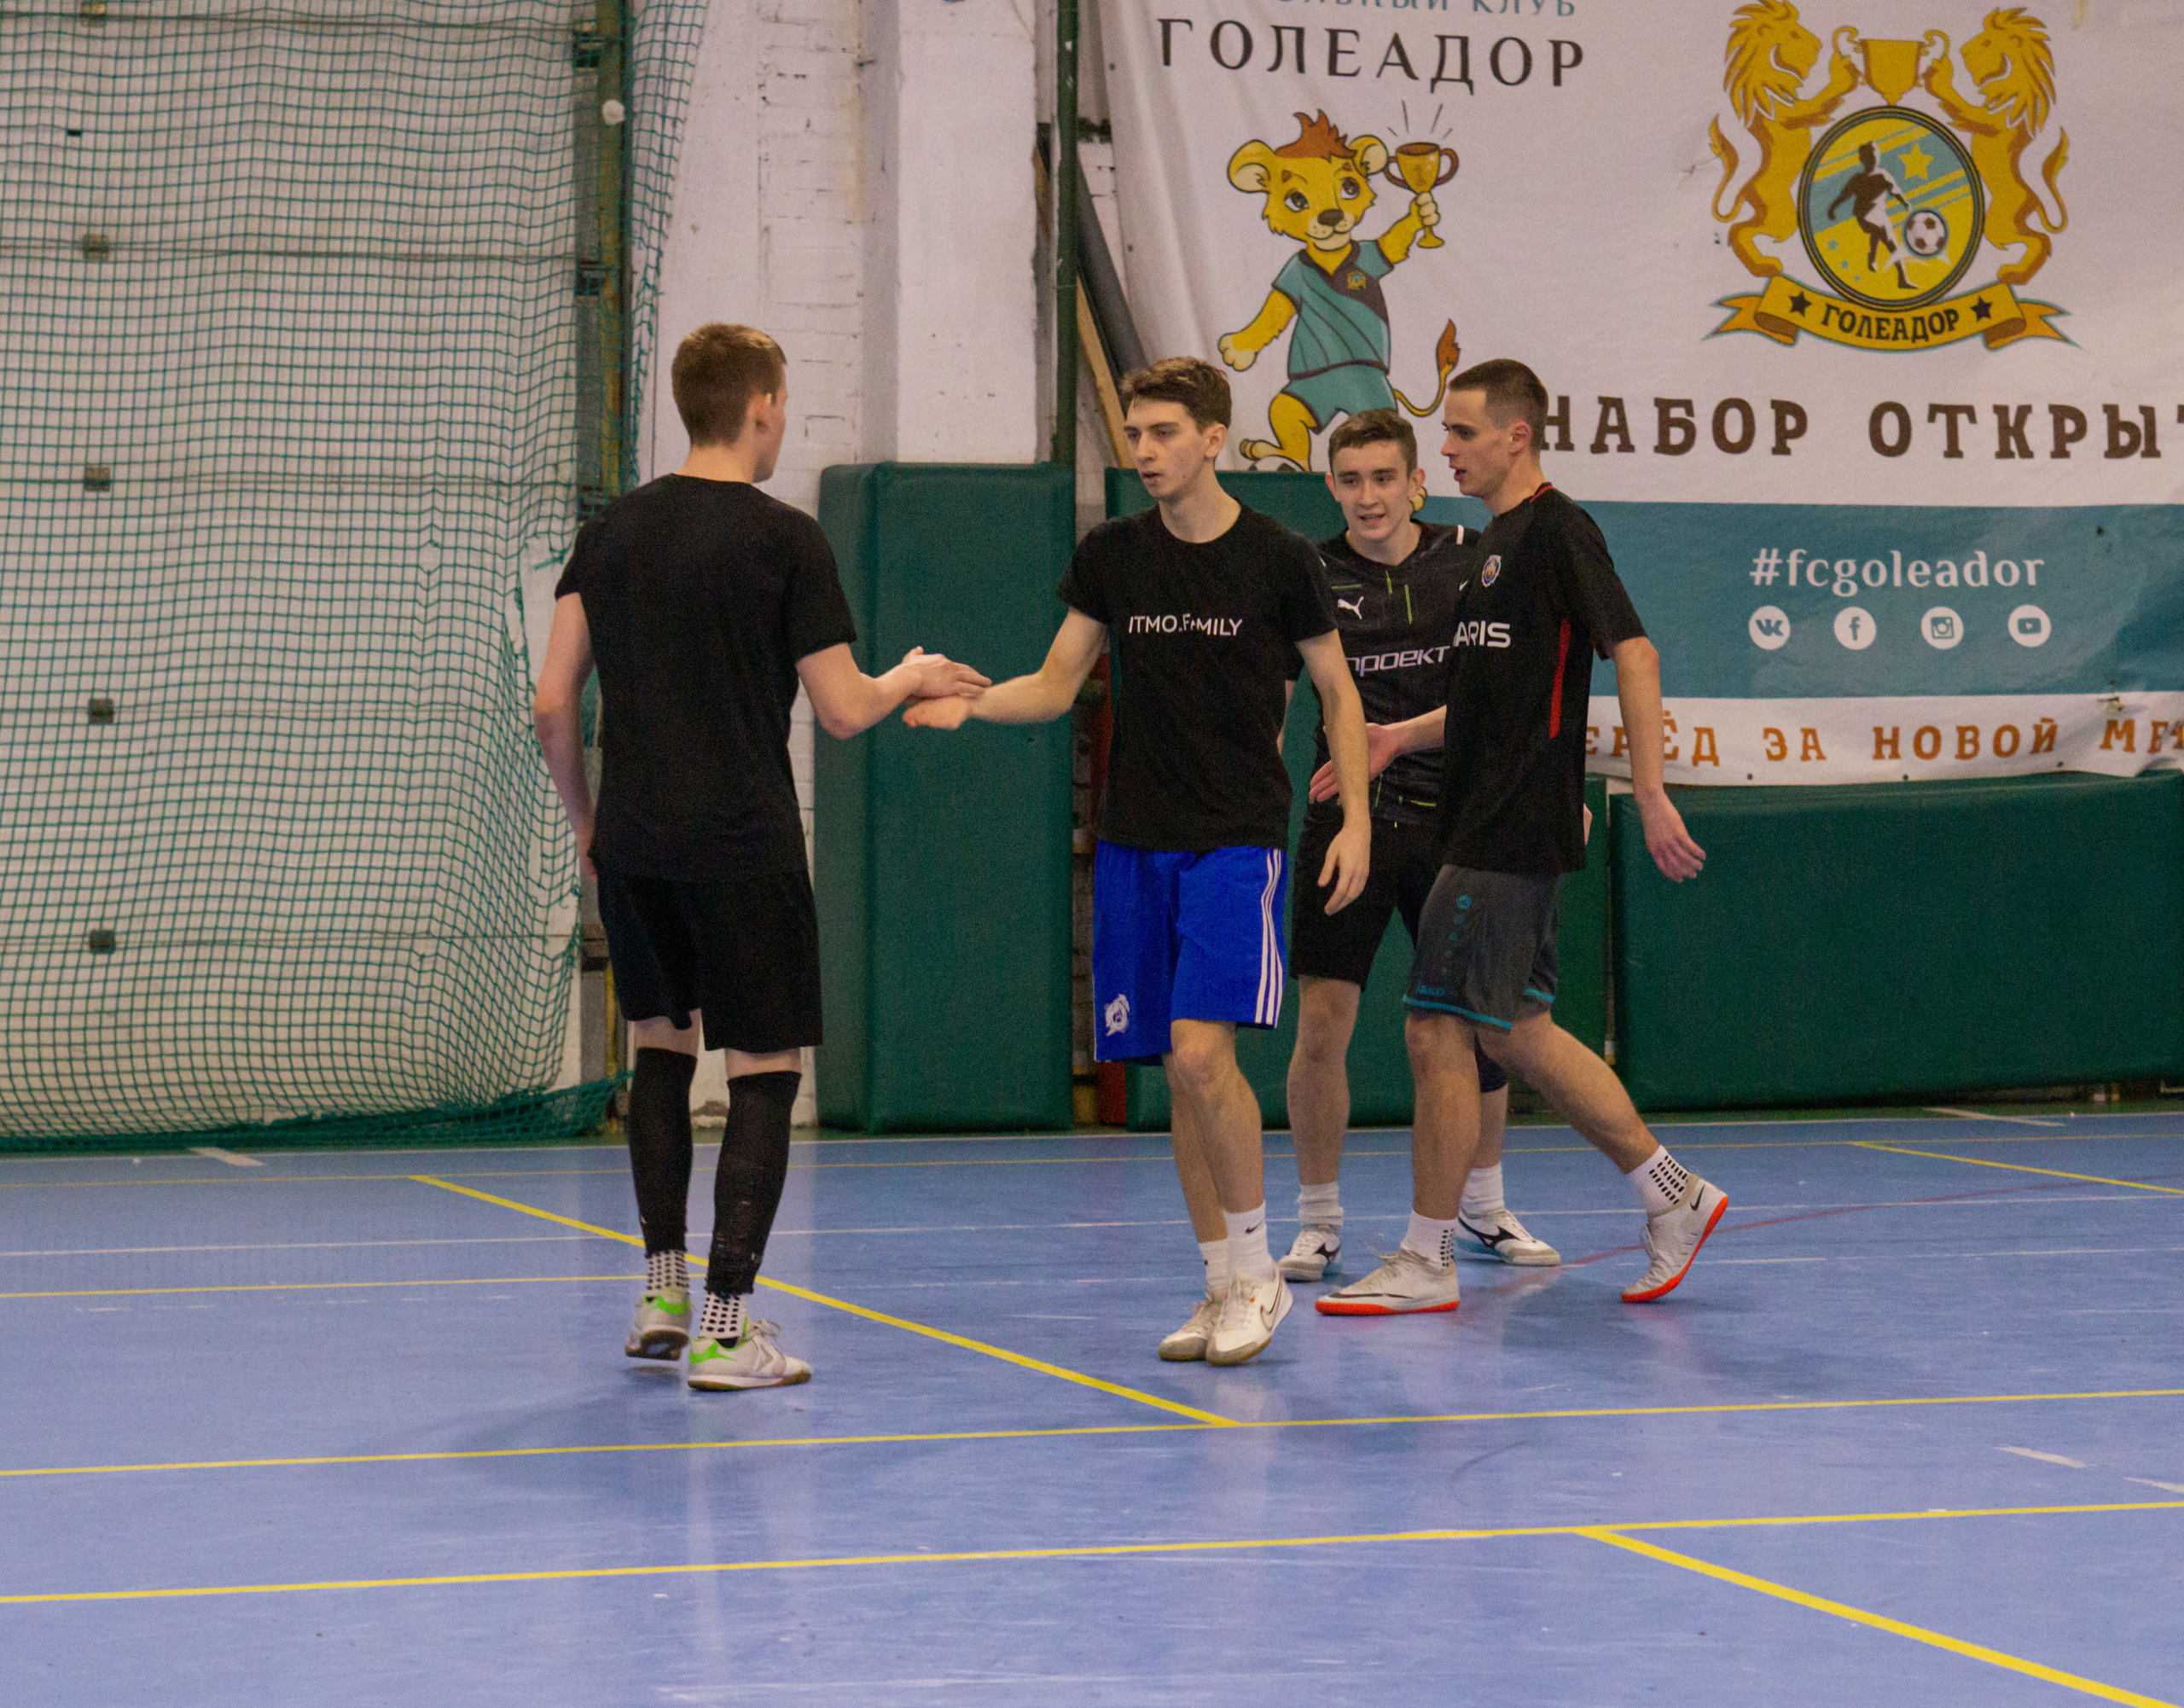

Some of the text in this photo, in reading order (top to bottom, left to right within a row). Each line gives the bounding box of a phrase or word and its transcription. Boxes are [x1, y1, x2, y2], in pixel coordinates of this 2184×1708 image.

[1157, 18, 1584, 96] ГОЛЕАДОР
[1821, 303, 1960, 343] ГОЛЕАДОР
[1541, 395, 2184, 460] НАБОР ОТКРЫ
[1749, 548, 2045, 597] #fcgoleador
[1873, 717, 2059, 761] НОВОЙ
